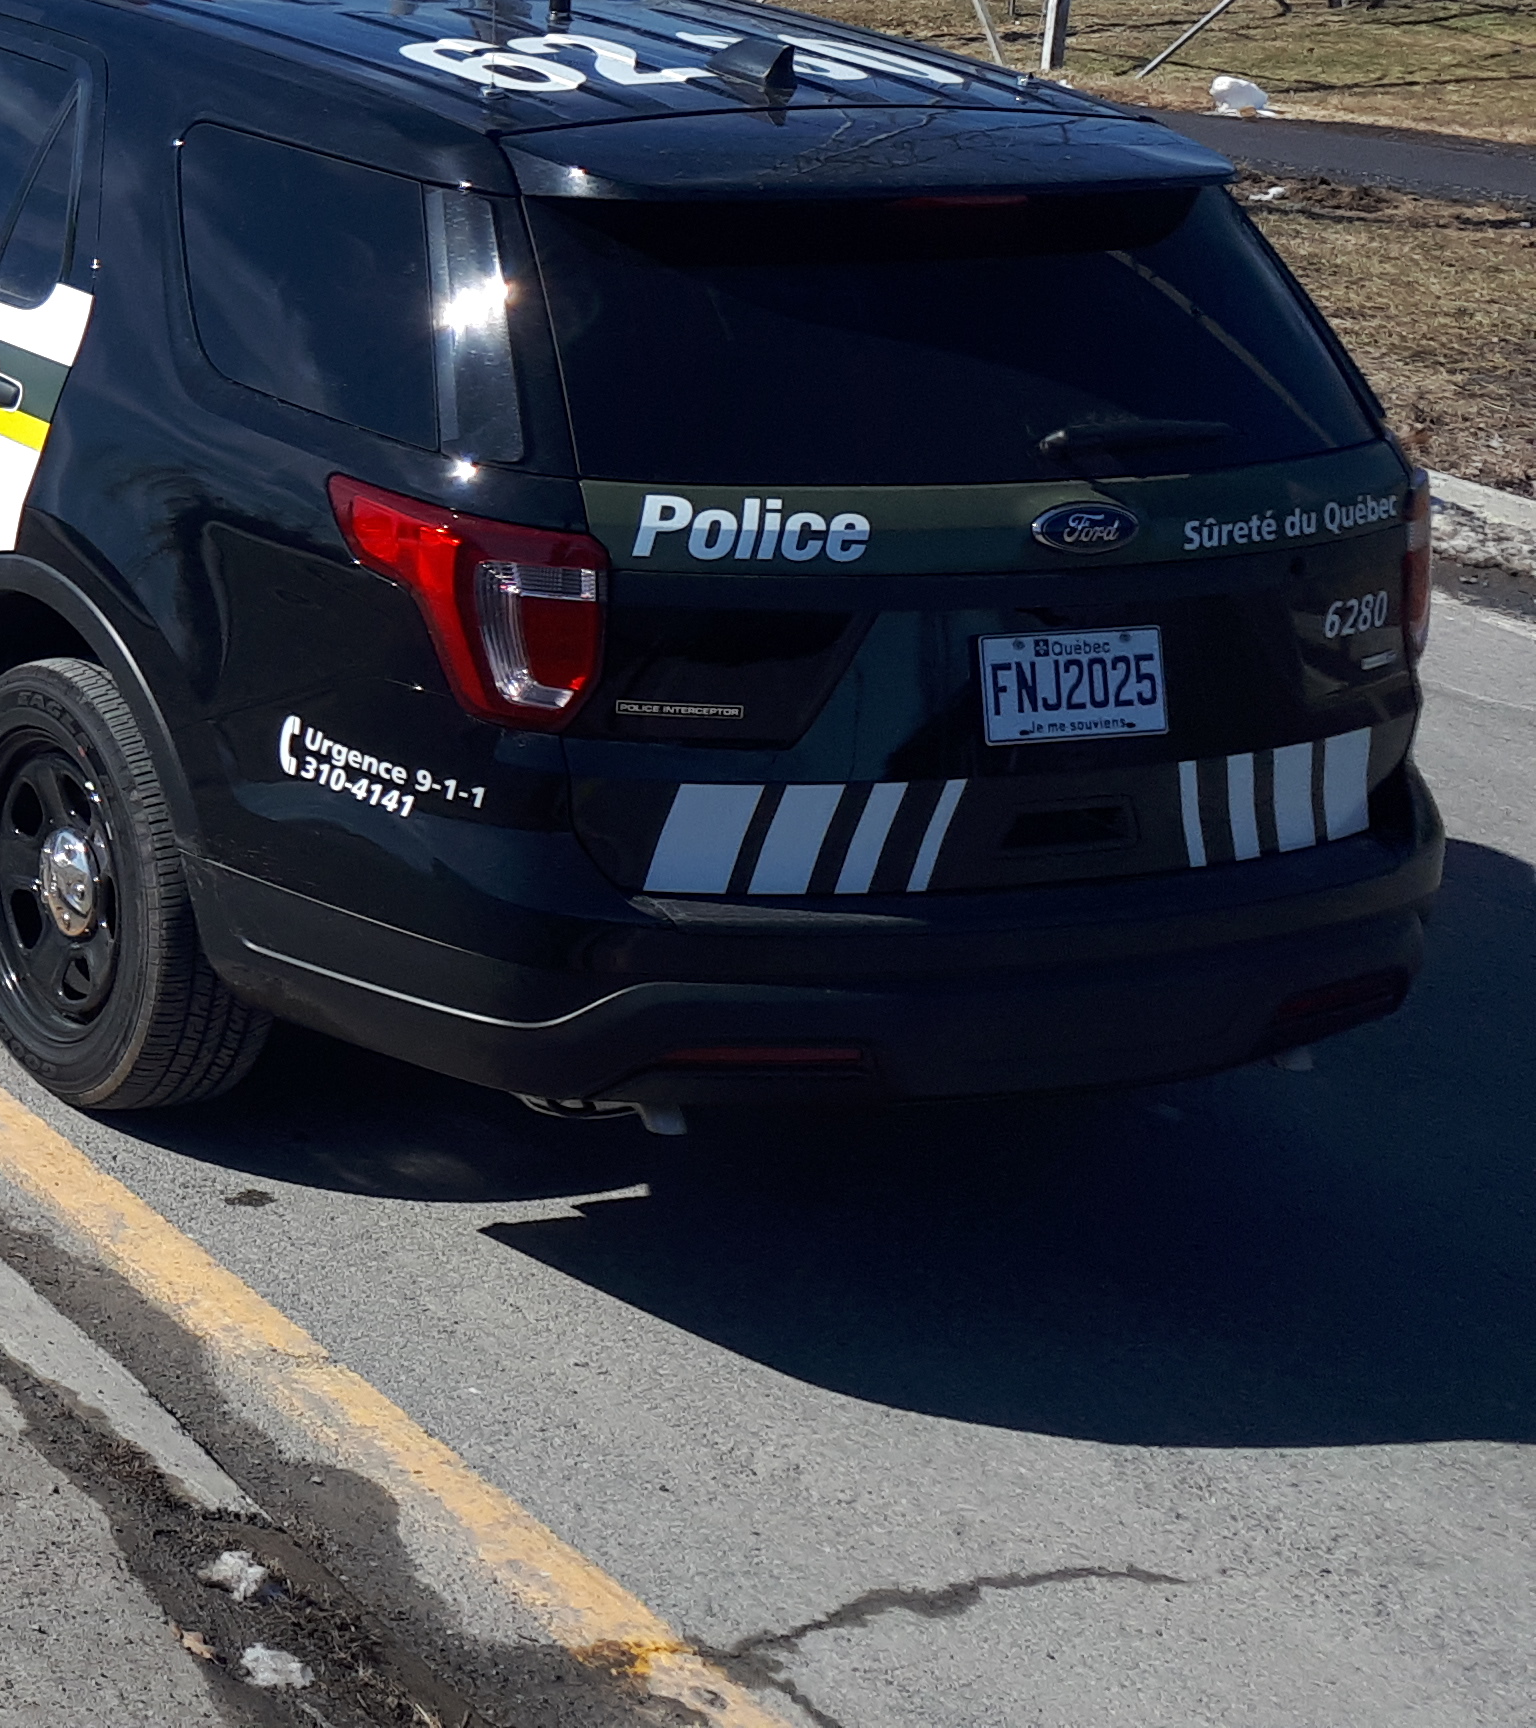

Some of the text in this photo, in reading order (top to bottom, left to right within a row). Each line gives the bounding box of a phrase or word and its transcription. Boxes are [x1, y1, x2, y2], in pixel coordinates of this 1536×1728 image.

[631, 494, 871, 562] Police
[1062, 512, 1120, 543] Ford
[1183, 494, 1398, 551] Sûreté du Québec
[1323, 591, 1388, 638] 6280
[1051, 639, 1111, 656] Québec
[619, 703, 740, 716] POLICE INTERCEPTOR
[989, 653, 1157, 717] FNJ2025
[1028, 717, 1127, 734] Je me souviens
[300, 756, 415, 817] 310-4141
[304, 726, 486, 808] Urgence 9-1-1
